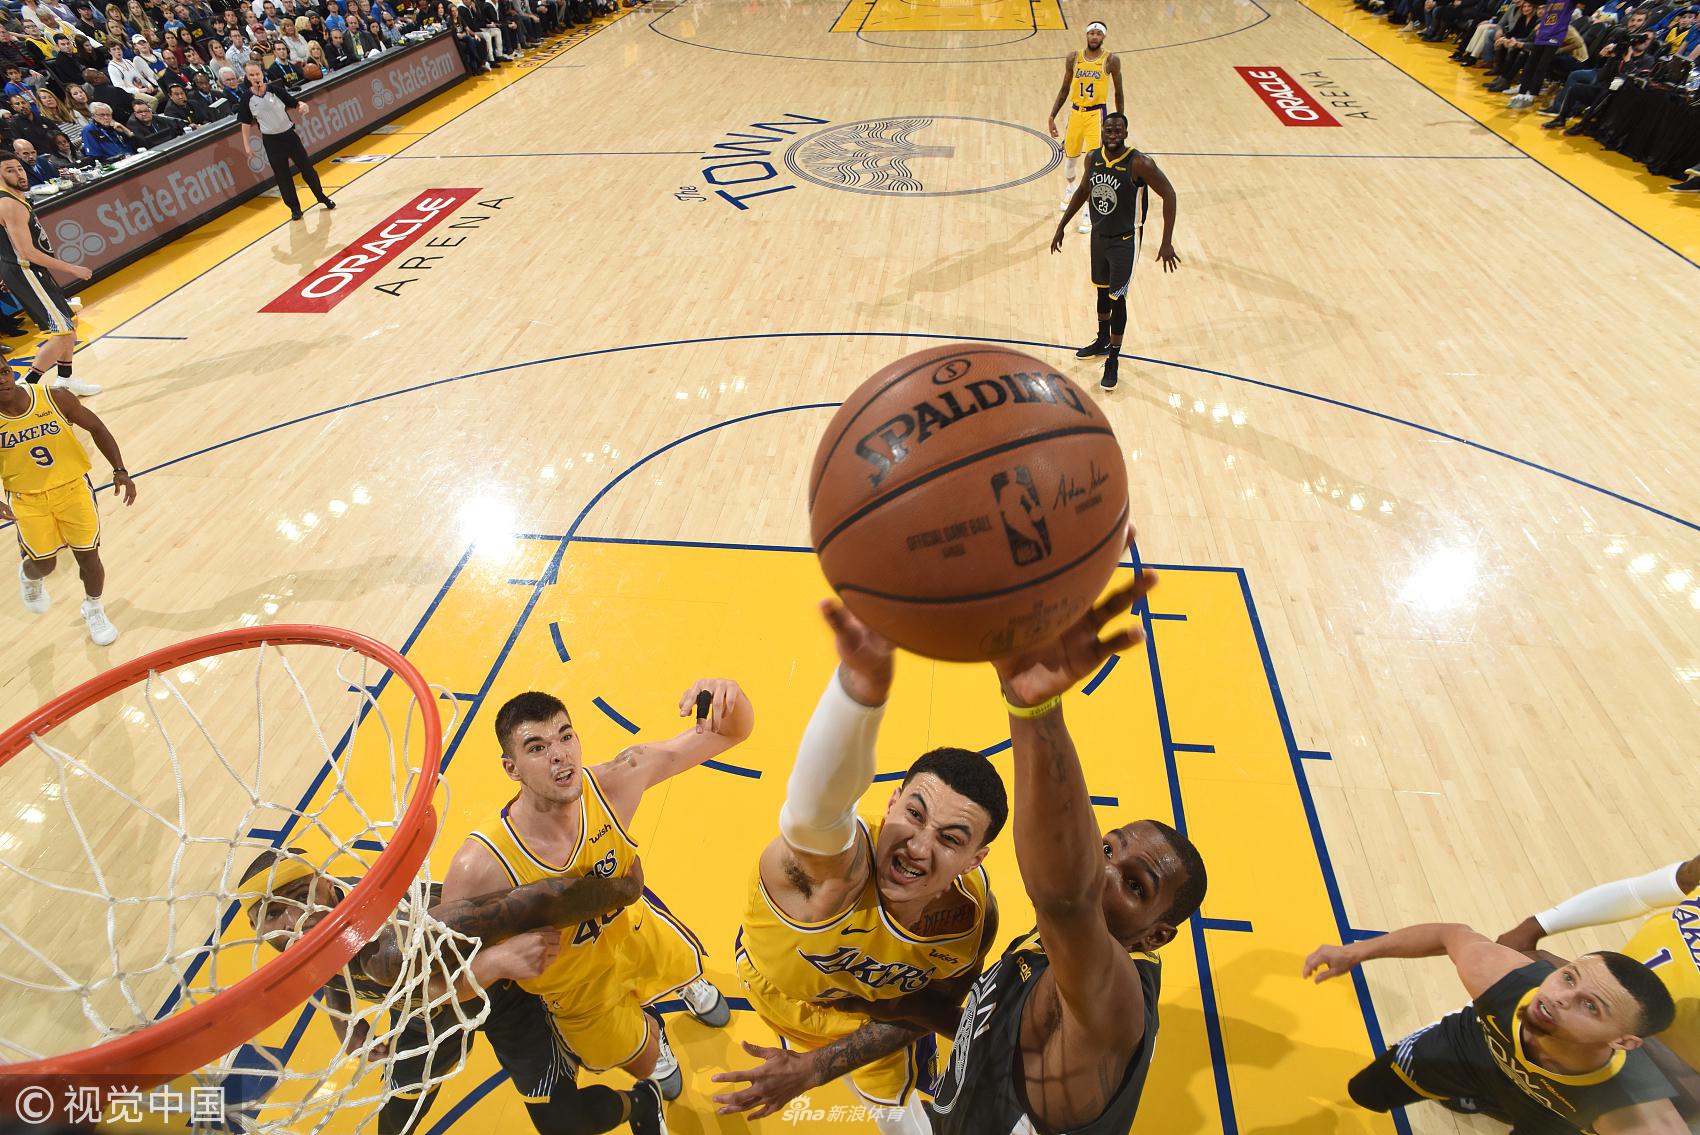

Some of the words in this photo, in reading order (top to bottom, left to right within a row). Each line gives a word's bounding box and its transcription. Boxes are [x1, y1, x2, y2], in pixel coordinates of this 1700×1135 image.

[1079, 82, 1095, 98] 14
[1248, 70, 1320, 121] ORACLE
[1300, 70, 1378, 121] ARENA
[295, 96, 365, 149] ateFarm
[700, 113, 831, 211] TOWN
[1089, 173, 1121, 191] TOWN
[1098, 200, 1109, 213] 23
[301, 196, 457, 298] ORACLE
[374, 196, 515, 297] ARENA
[34, 410, 53, 418] wish
[855, 371, 1087, 488] SPALDING
[0, 420, 61, 449] LAKERS
[29, 445, 55, 468] 9
[589, 823, 612, 844] wish
[796, 946, 937, 993] LAKERS
[929, 948, 959, 965] wish
